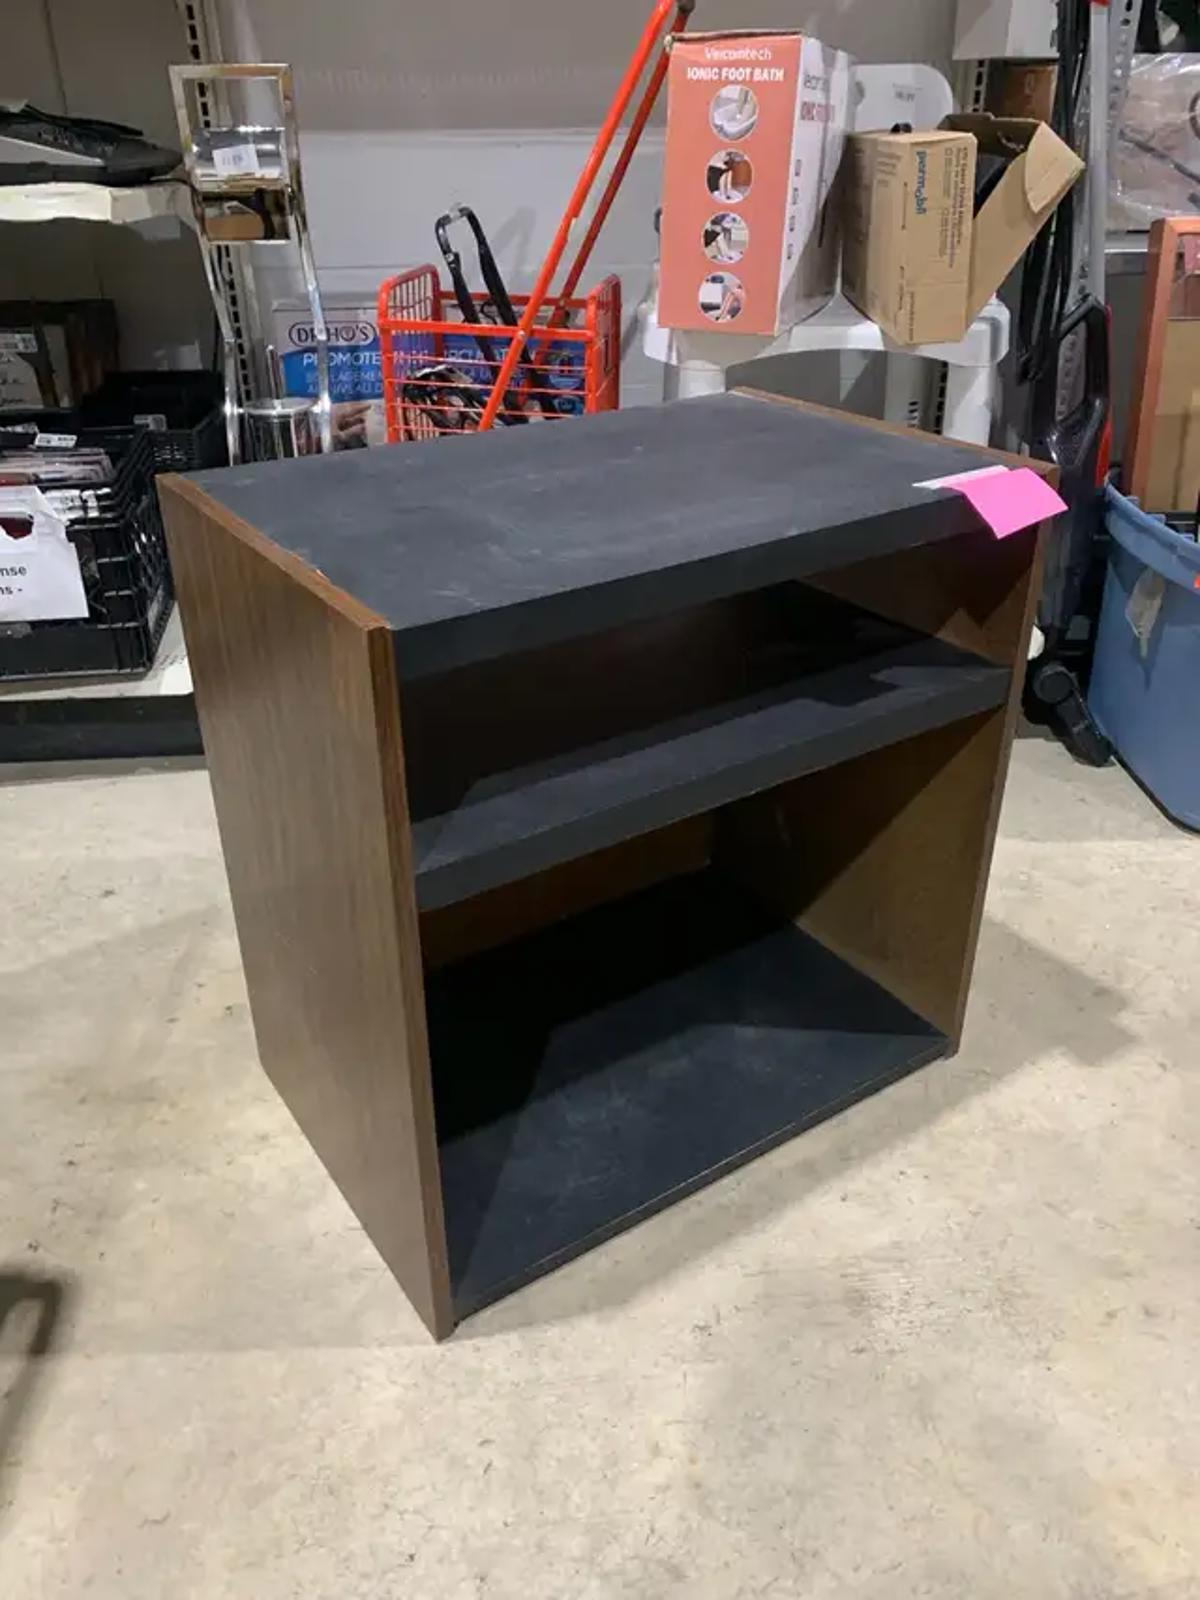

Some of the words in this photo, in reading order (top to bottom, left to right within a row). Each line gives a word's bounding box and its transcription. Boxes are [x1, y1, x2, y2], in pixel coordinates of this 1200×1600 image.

[687, 66, 719, 81] IONIC
[721, 66, 752, 81] FOOT
[752, 67, 785, 82] BATH
[915, 150, 928, 215] permobil
[303, 351, 381, 367] POMOTE
